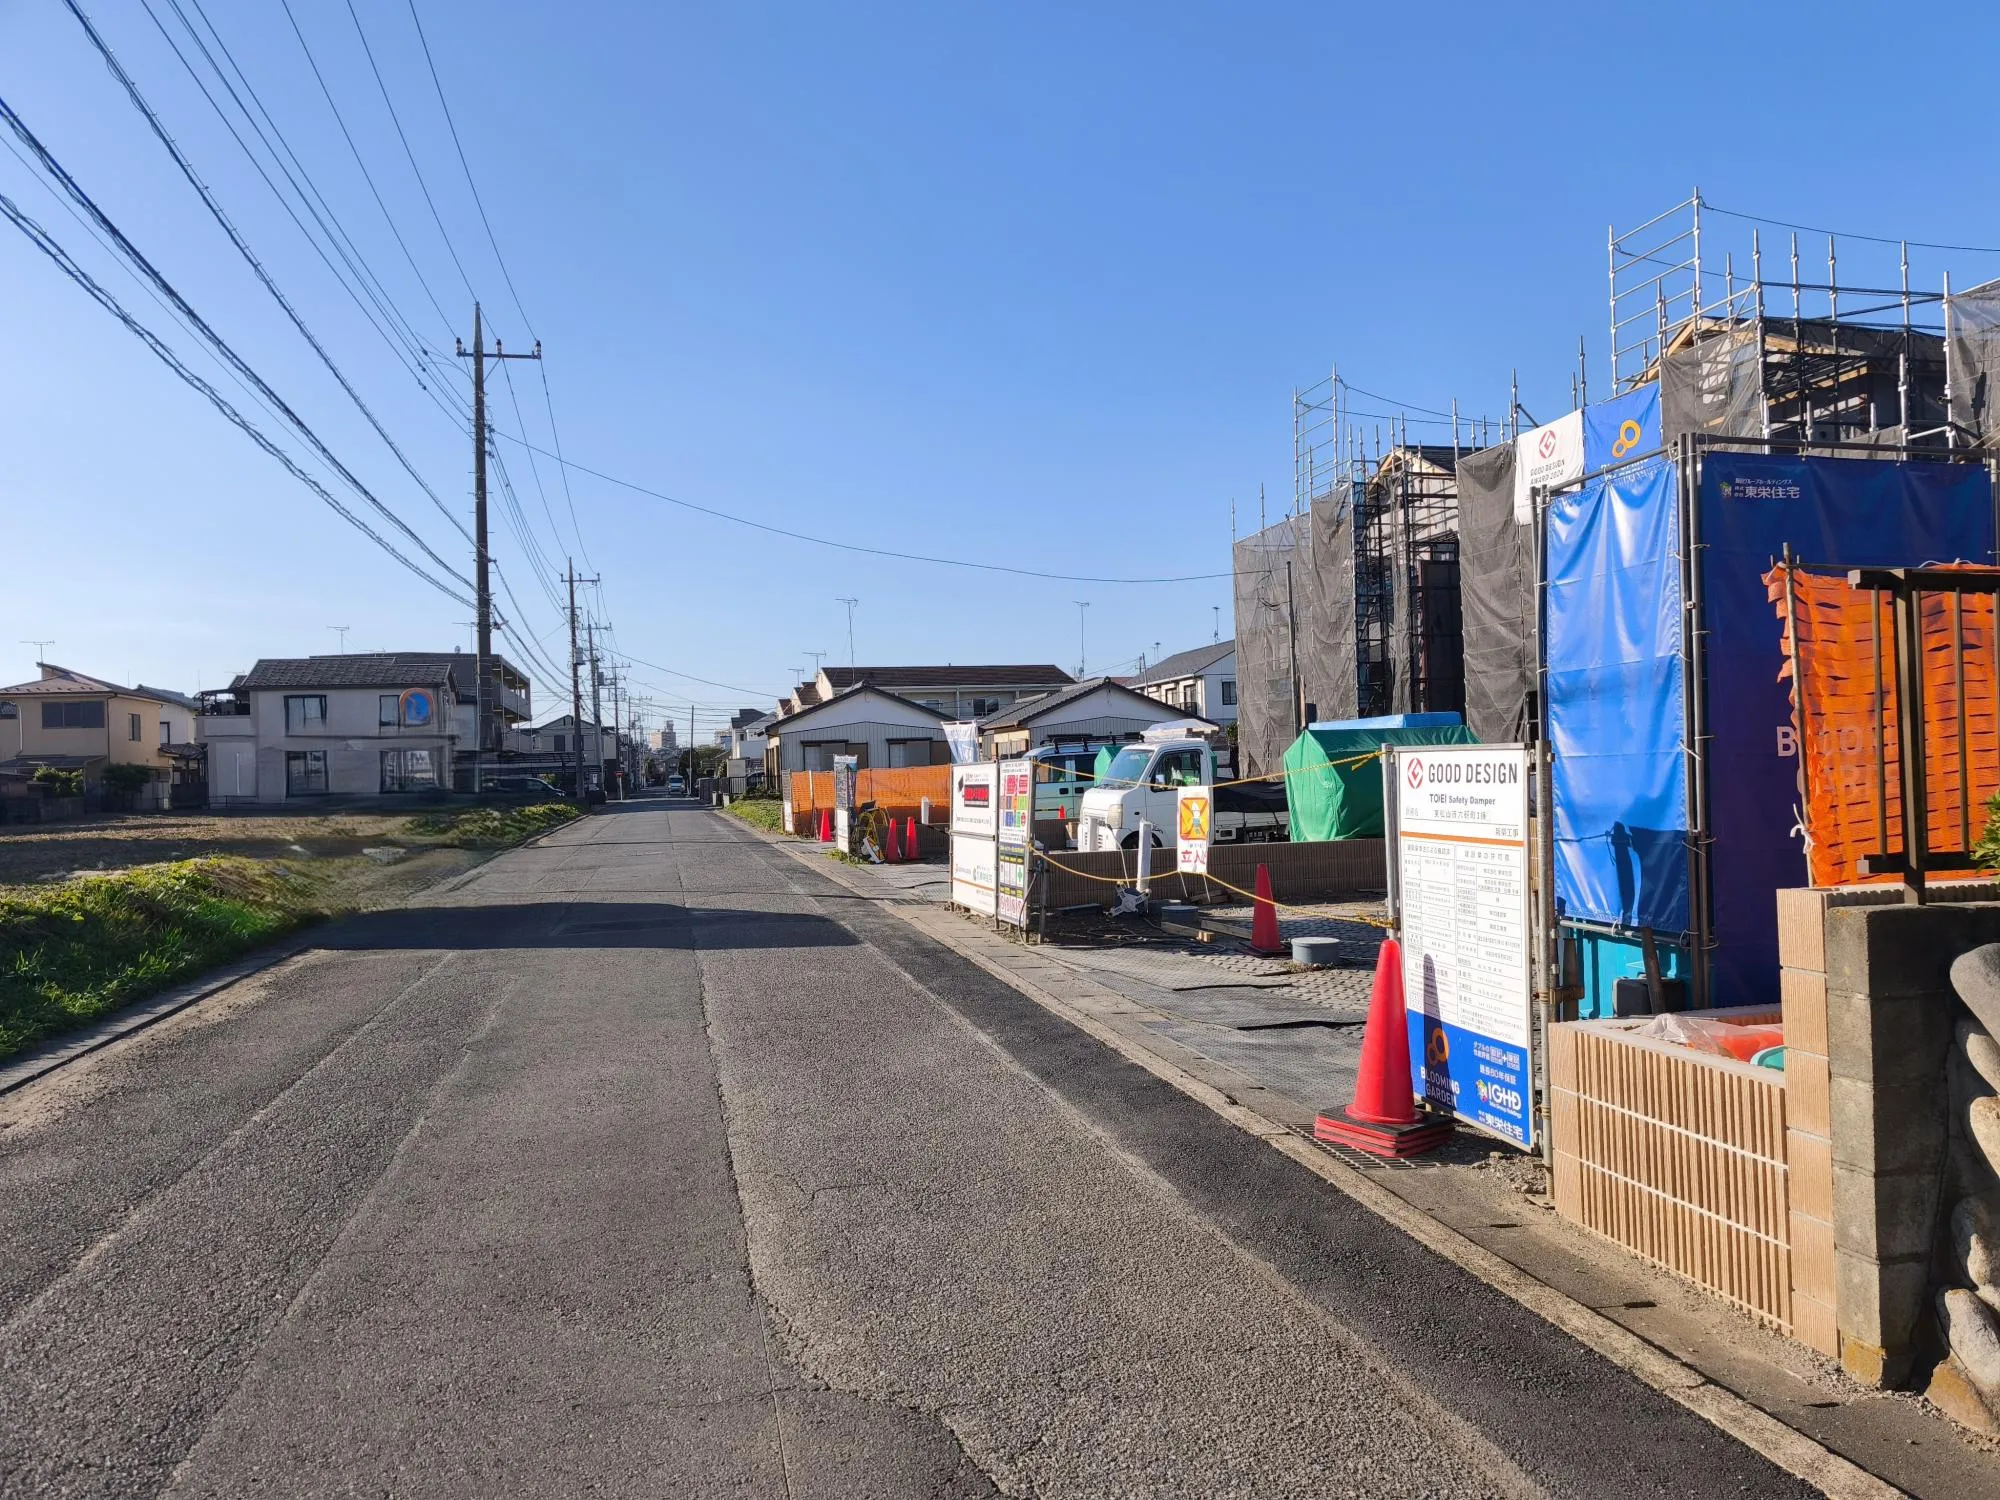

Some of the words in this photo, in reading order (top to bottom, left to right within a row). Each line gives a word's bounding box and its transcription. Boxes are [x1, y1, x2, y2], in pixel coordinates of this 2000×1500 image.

[1744, 486, 1800, 499] 東栄住宅
[1428, 763, 1461, 784] GOOD
[1465, 762, 1518, 784] DESIGN
[1448, 796, 1468, 806] Safety
[1469, 796, 1496, 806] Damper
[1420, 1066, 1459, 1095] BLOOMING
[1426, 1083, 1457, 1108] GARDEN
[1485, 1112, 1523, 1139] 東栄住宅
